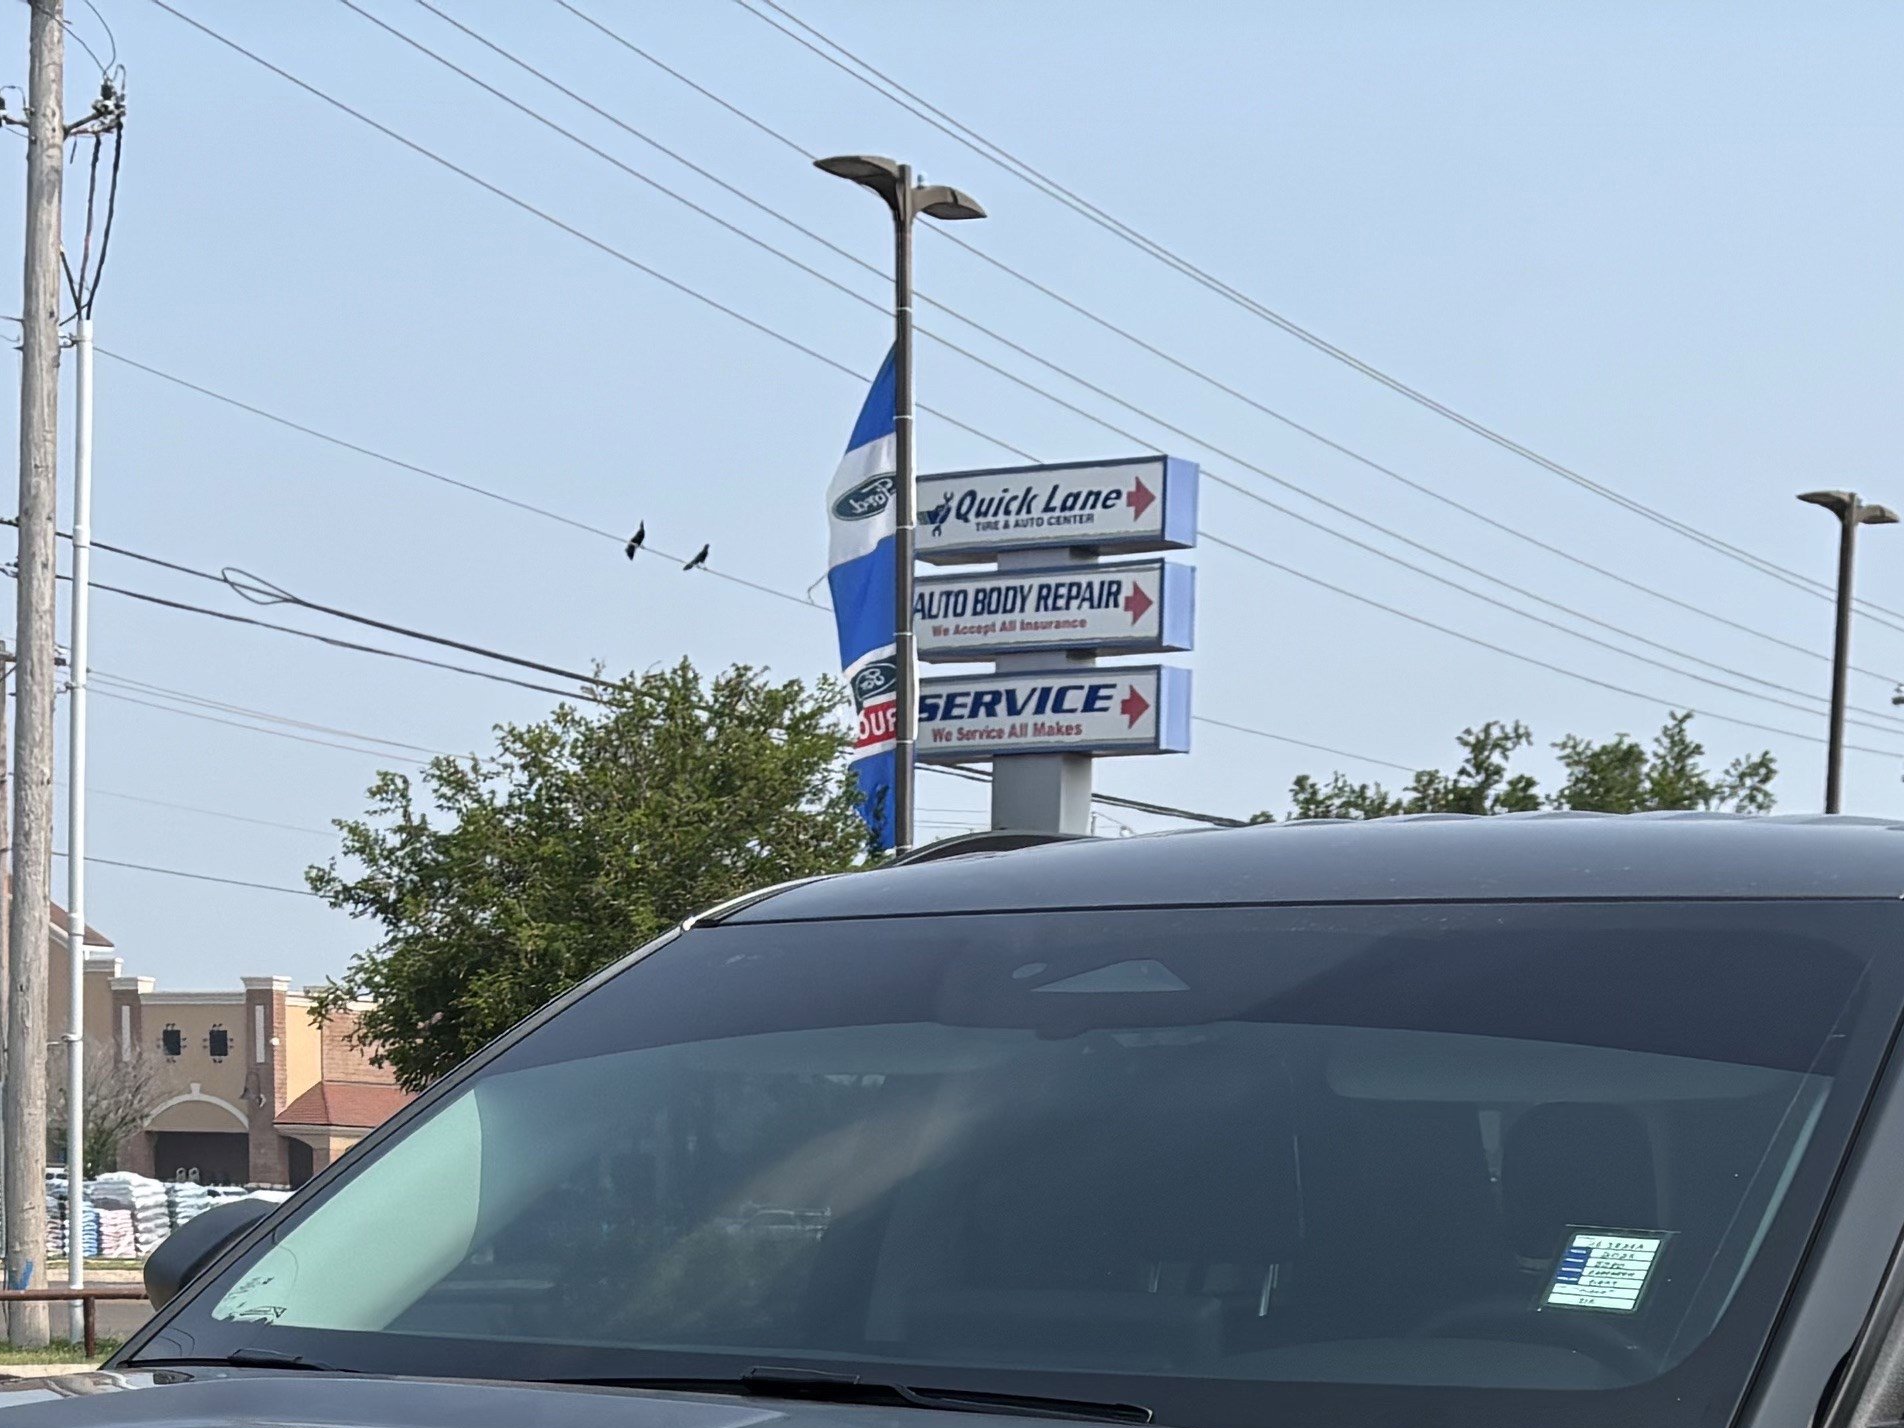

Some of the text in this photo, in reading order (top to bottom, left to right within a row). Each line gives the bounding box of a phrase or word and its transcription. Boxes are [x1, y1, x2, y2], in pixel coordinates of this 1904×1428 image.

[955, 484, 1122, 523] Quick Lane
[975, 513, 1095, 532] TIRE & AUTO CENTER
[913, 579, 1122, 621] AUTO BODY REPAIR
[931, 616, 1088, 637] We Accept All Insurance
[918, 683, 1118, 723] SERVICE
[931, 721, 1083, 743] We Service All Makes
